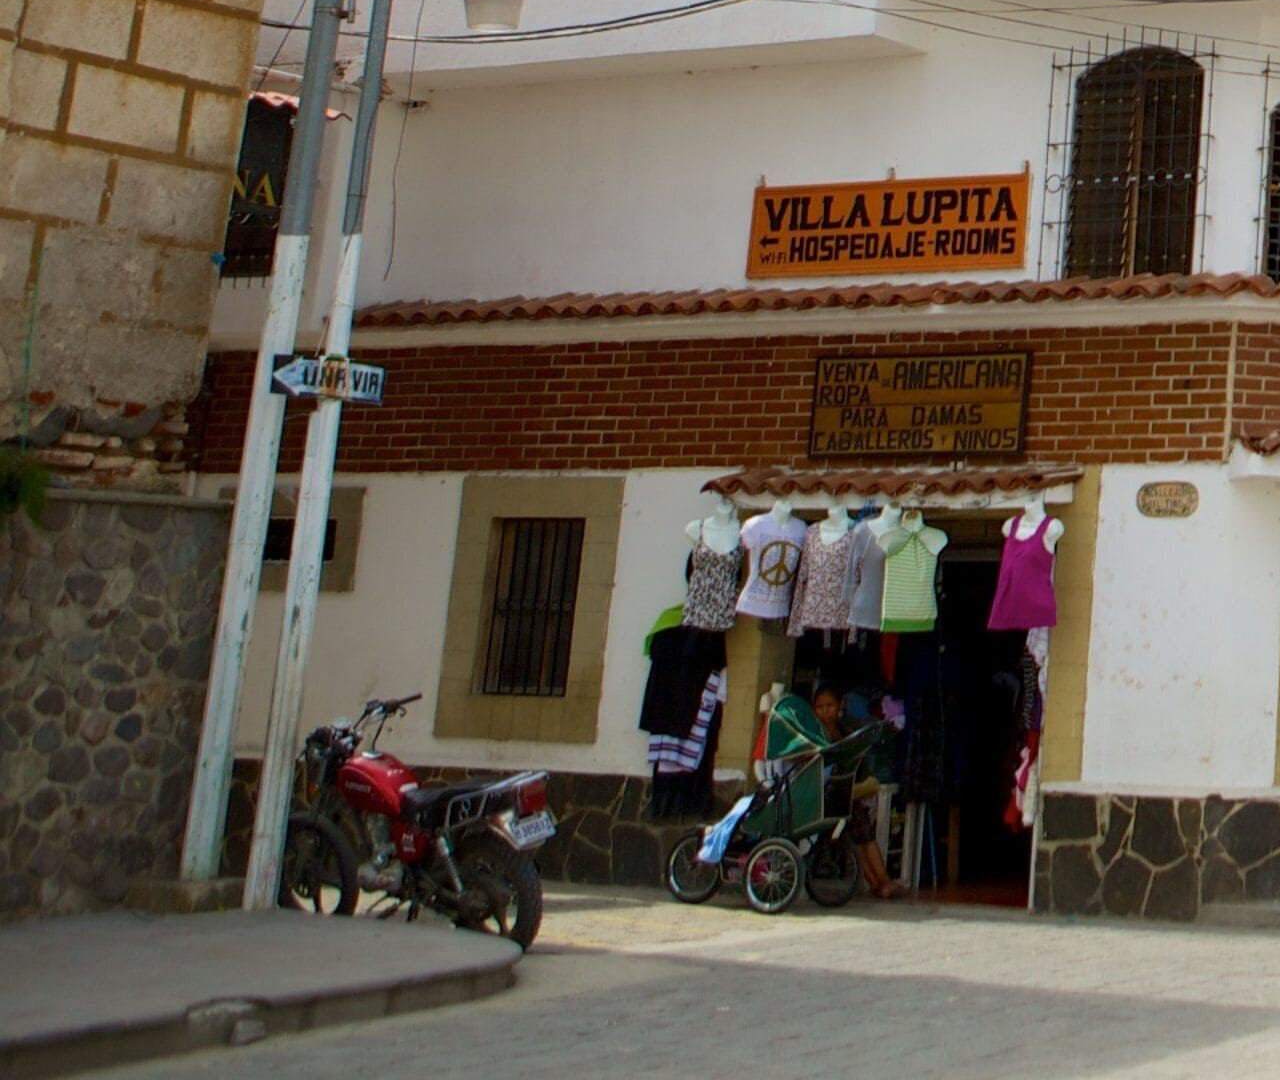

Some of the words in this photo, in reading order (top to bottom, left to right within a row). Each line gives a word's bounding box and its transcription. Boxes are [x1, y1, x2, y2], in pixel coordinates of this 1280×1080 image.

[764, 192, 871, 232] VILLA
[880, 186, 1018, 226] LUPITA
[822, 361, 880, 384] VENTA
[893, 358, 1023, 390] AMERICANA
[819, 385, 871, 406] ROPA
[840, 406, 889, 429] PARA
[911, 404, 984, 427] DAMAS
[813, 428, 933, 452] CABALLEROS
